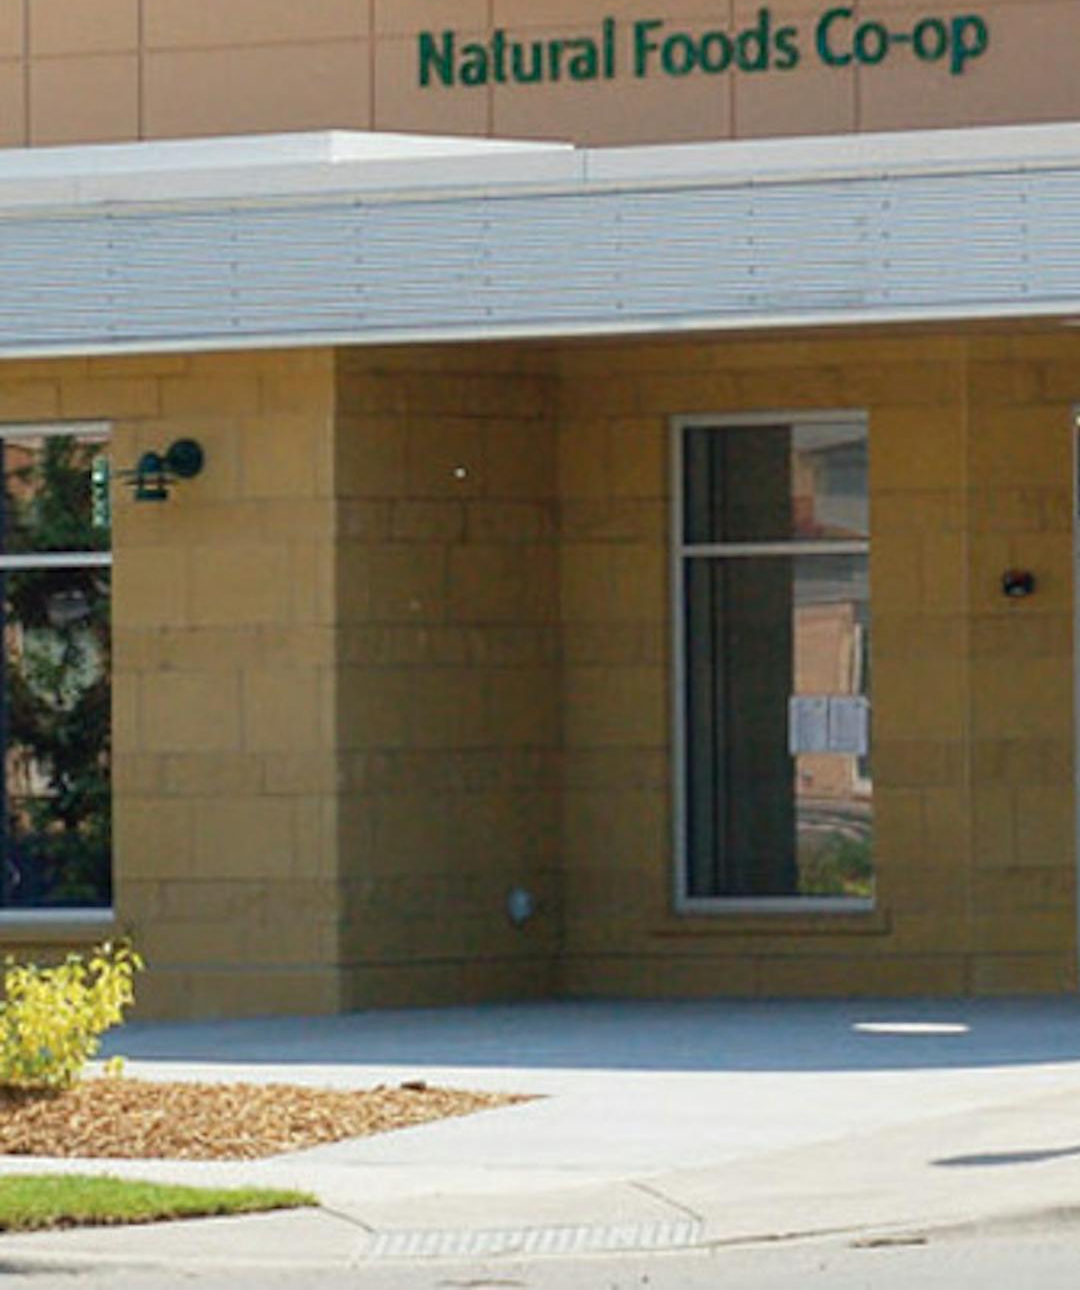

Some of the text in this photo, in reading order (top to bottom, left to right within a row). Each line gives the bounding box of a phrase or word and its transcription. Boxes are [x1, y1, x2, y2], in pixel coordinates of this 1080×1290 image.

[416, 7, 989, 87] Natural Foods Co-op
